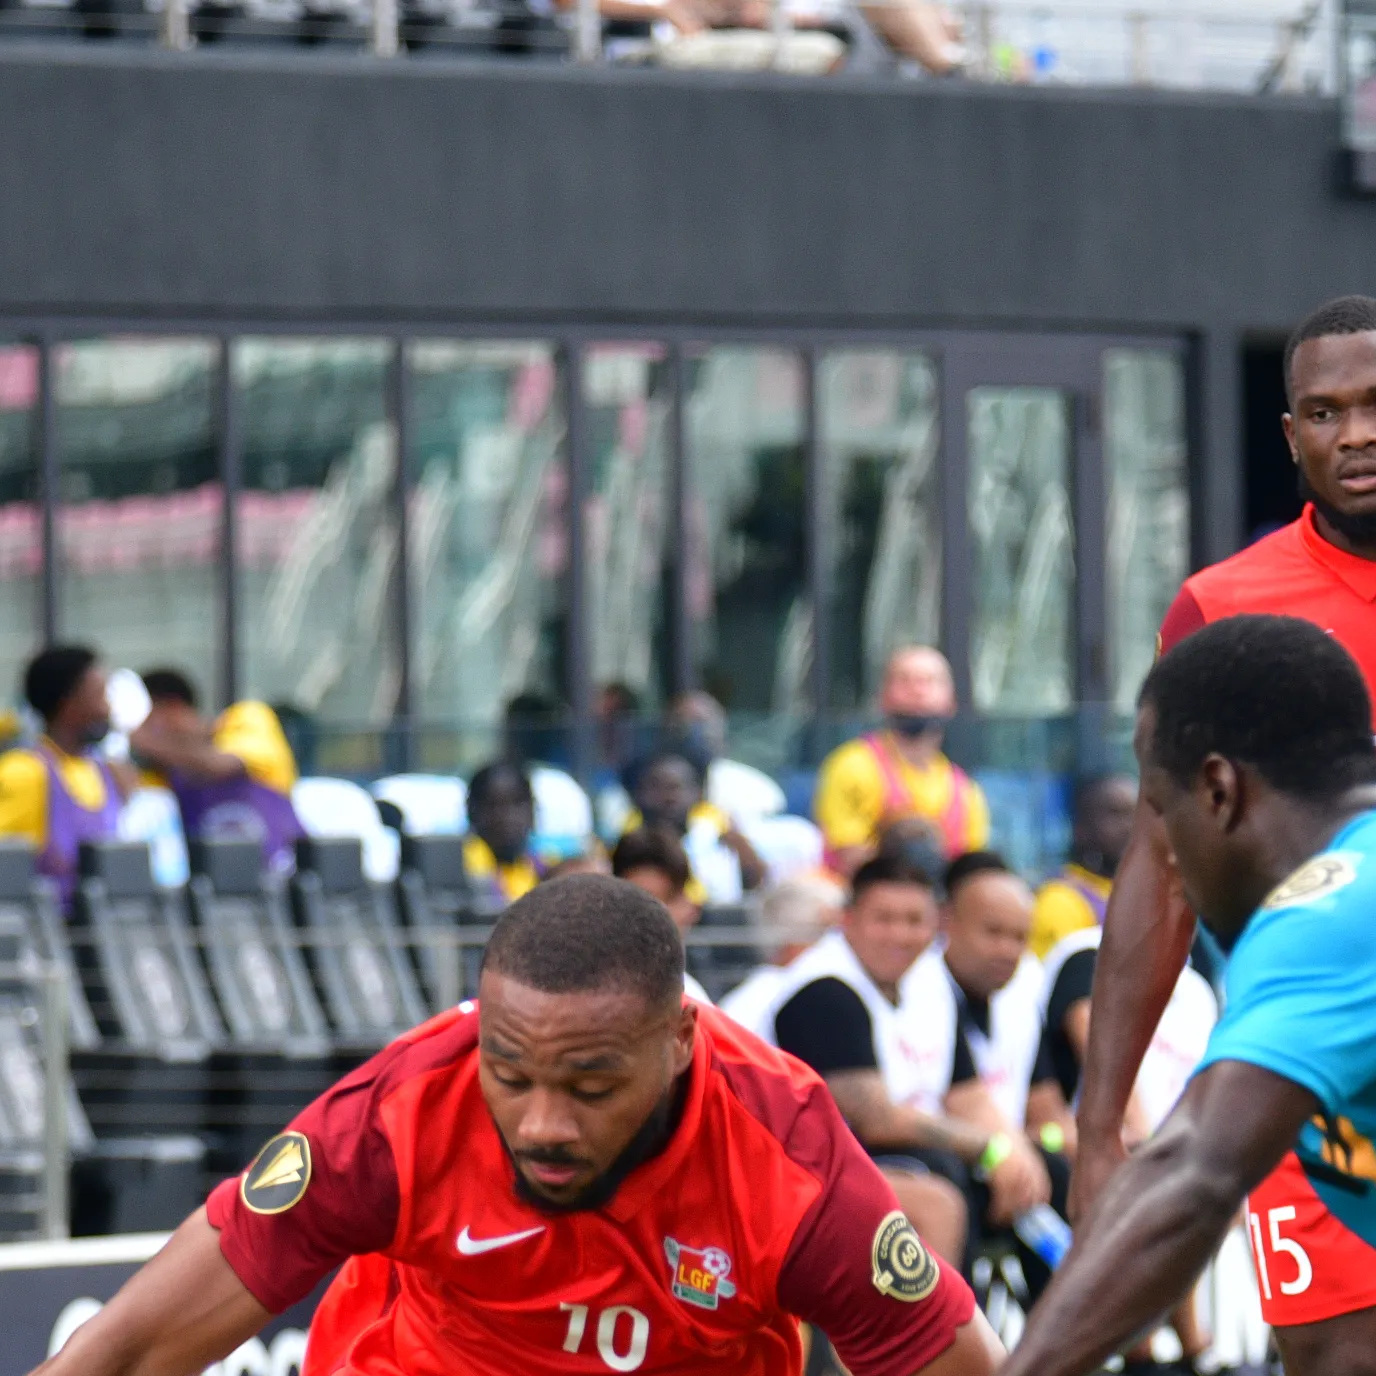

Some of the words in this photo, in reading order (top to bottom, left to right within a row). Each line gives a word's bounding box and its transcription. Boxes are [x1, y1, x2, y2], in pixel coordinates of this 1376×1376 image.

[679, 1263, 716, 1292] LGF
[902, 1242, 918, 1268] 60
[1248, 1205, 1313, 1301] 15
[559, 1301, 650, 1373] 10
